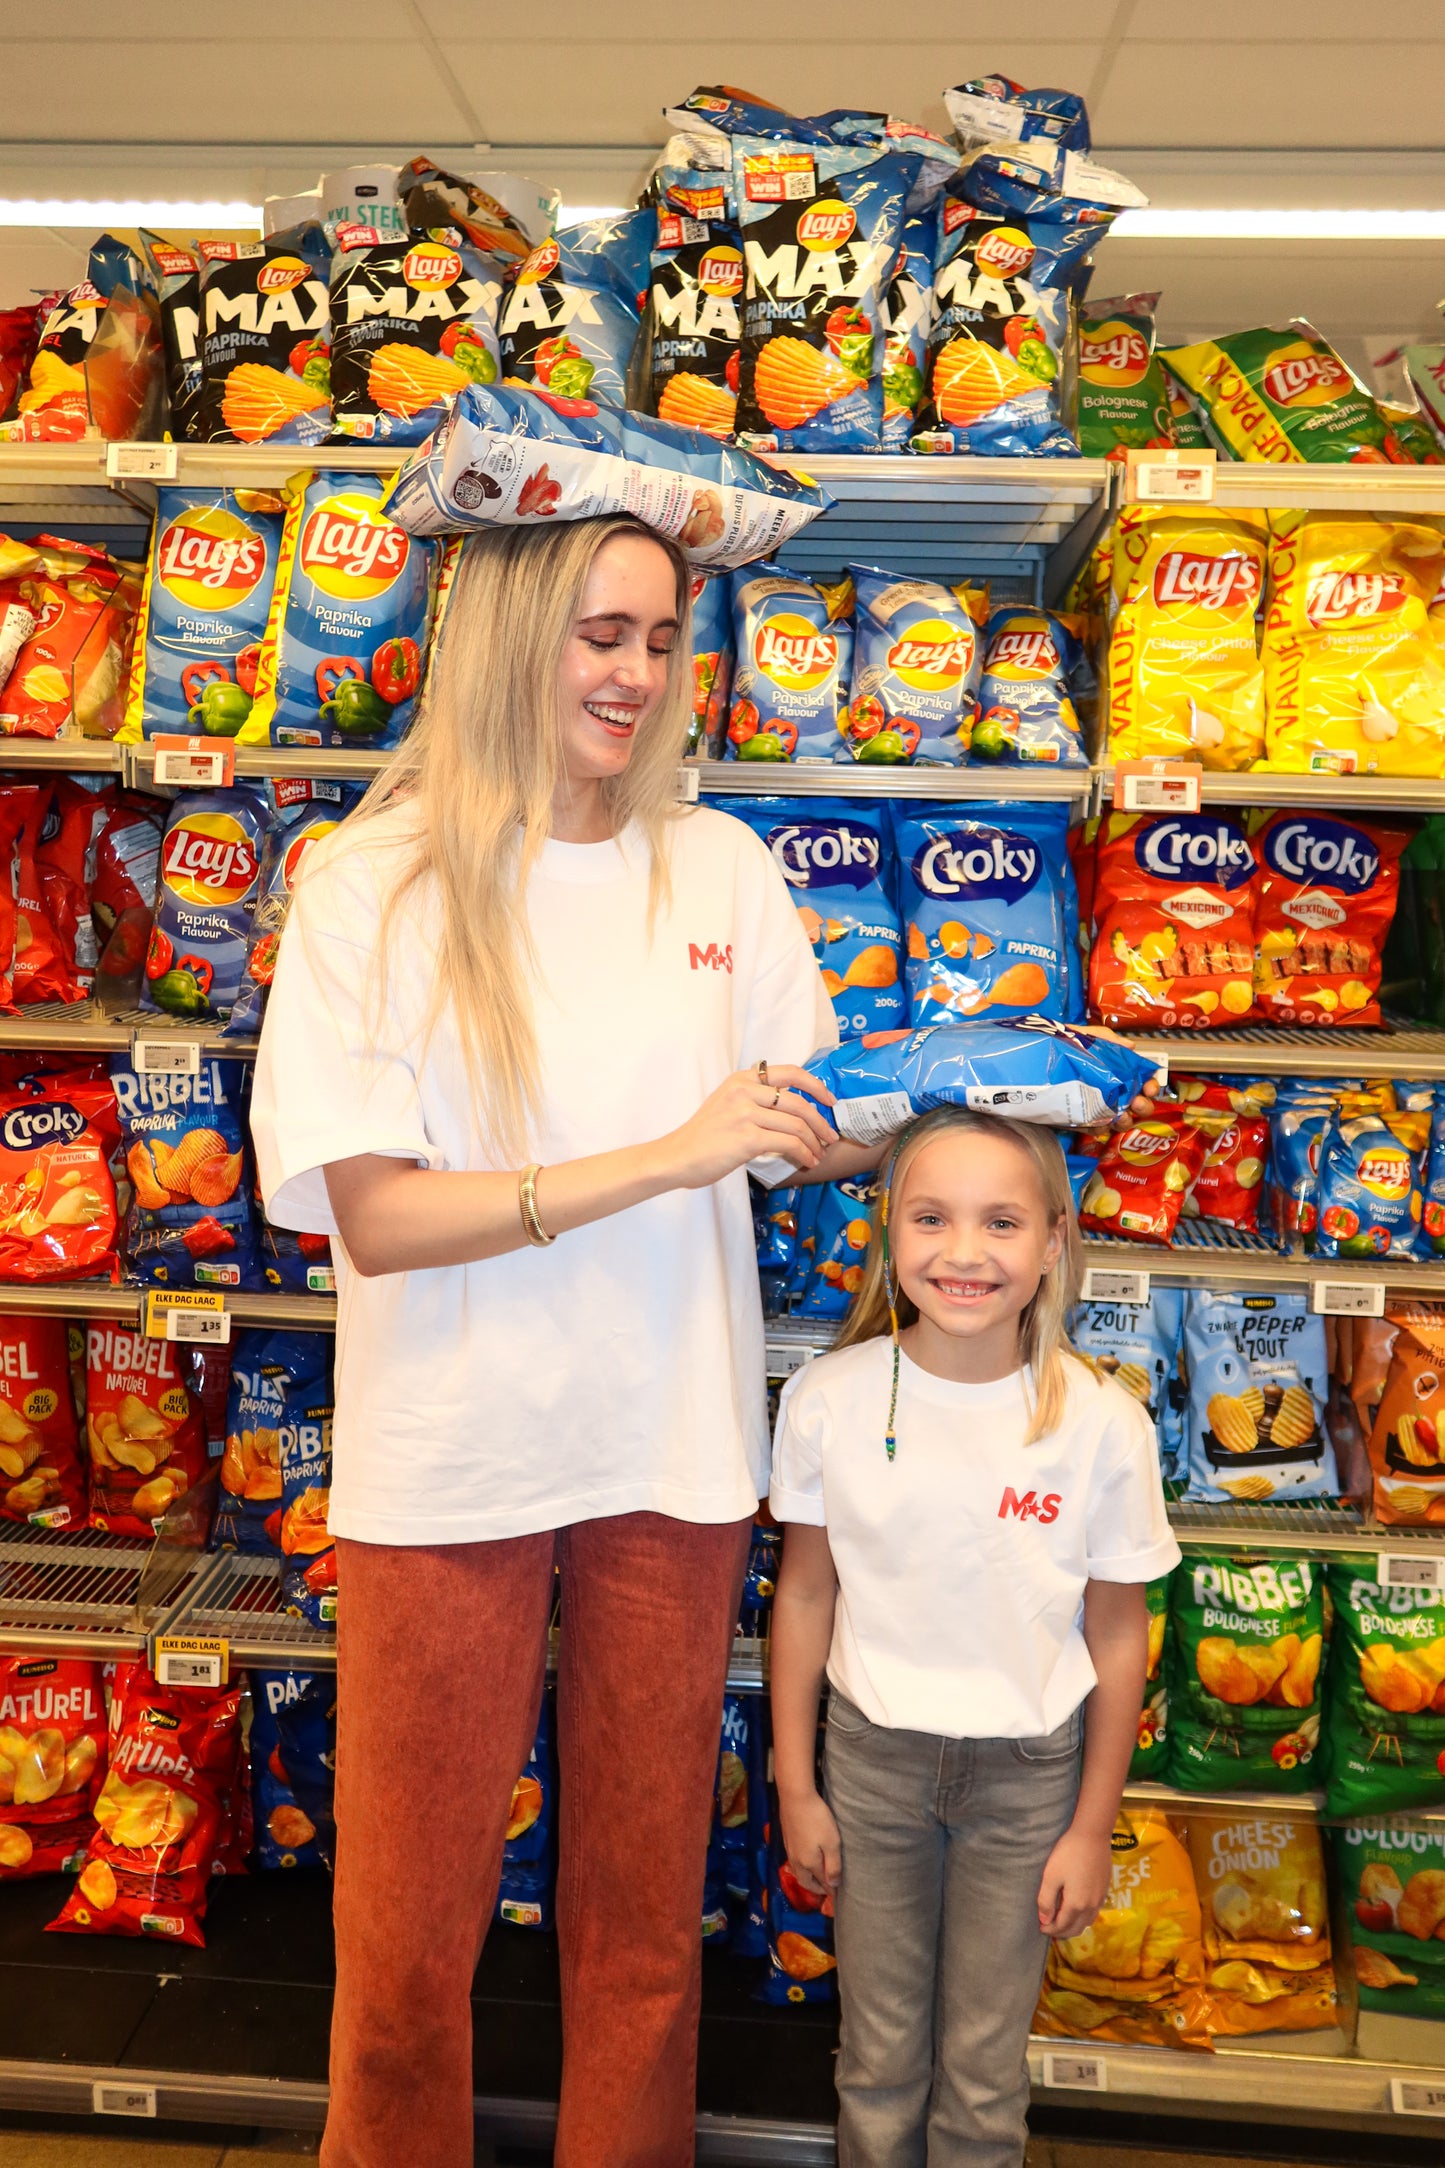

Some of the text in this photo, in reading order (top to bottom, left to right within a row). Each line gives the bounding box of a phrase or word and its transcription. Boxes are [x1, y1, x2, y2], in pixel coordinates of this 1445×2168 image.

[750, 183, 781, 193] WIN
[801, 209, 854, 246] Lay's
[978, 237, 1034, 275] Lay's
[259, 263, 312, 291] Lay's
[407, 253, 459, 286] Lay's
[743, 241, 895, 300] MAX
[346, 276, 502, 323] MAX
[936, 258, 1060, 325] MAX
[746, 301, 806, 323] PAPRIKA
[204, 333, 269, 355] PAPRIKA
[204, 349, 237, 366] FLAVOUR
[1272, 357, 1342, 402] Lay's
[1082, 395, 1148, 409] Bolognese
[1099, 409, 1140, 420] Flavour
[1327, 413, 1368, 433] Flavour
[732, 494, 744, 526] DEPUIS
[770, 508, 786, 534] MEER
[305, 513, 407, 577] Lay's
[163, 527, 257, 589] Lay's
[1160, 553, 1260, 611] Lay's
[1308, 572, 1405, 621] Lay's
[177, 616, 234, 637] Paprika
[315, 604, 373, 629] Paprika
[319, 621, 364, 639] Flavour
[1268, 525, 1306, 737] VALUE PACK
[761, 630, 835, 676] Lay's
[893, 631, 973, 675] Lay's
[1152, 637, 1207, 651] Cheese
[1112, 617, 1136, 737] VALUE
[772, 691, 825, 708] Paprika
[899, 690, 952, 711] Paprika
[777, 706, 819, 719] Flavour
[279, 785, 306, 799] WIN
[165, 832, 252, 890] Lay's
[772, 827, 880, 889] Croky
[1144, 823, 1256, 874] Croky
[1274, 824, 1378, 893] Croky
[921, 838, 1036, 894] Croky
[177, 911, 230, 929] Paprika
[1170, 900, 1225, 918] MEXICANO
[1289, 902, 1341, 921] MEXICANO
[181, 927, 222, 940] Flavour
[1007, 941, 1057, 963] PAPRIKA
[111, 1059, 229, 1118] RIBBEL
[4, 1105, 85, 1148] Croky
[130, 1113, 177, 1132] PAPRIKA
[1121, 1126, 1176, 1154] Lay's
[1116, 1170, 1148, 1185] Naturel
[1361, 1158, 1411, 1185] Lay's
[1370, 1204, 1405, 1218] Paprika
[156, 1294, 215, 1305] ELKE DAG LAAG
[1245, 1299, 1275, 1308] JUMBO
[1091, 1310, 1138, 1334] ZOUT
[1241, 1315, 1307, 1345] PEPER
[87, 1331, 174, 1379] RIBBEL
[1247, 1338, 1289, 1362] ZOUT
[106, 1373, 148, 1397] NATUREL
[28, 1402, 52, 1414] PACK
[33, 1395, 50, 1406] BIG
[163, 1402, 188, 1415] PACK
[168, 1395, 184, 1406] BIG
[239, 1397, 284, 1419] PAPRIKA
[283, 1458, 329, 1486] PAPRIKA
[1203, 1609, 1279, 1636] BOLOGNESE
[1360, 1613, 1437, 1638] BOLOGNESE
[162, 1639, 221, 1651] ELKE DAG LAAG
[22, 1663, 55, 1674] JUMBO
[1212, 1821, 1298, 1856] CHEESE
[1208, 1848, 1280, 1880] ONION
